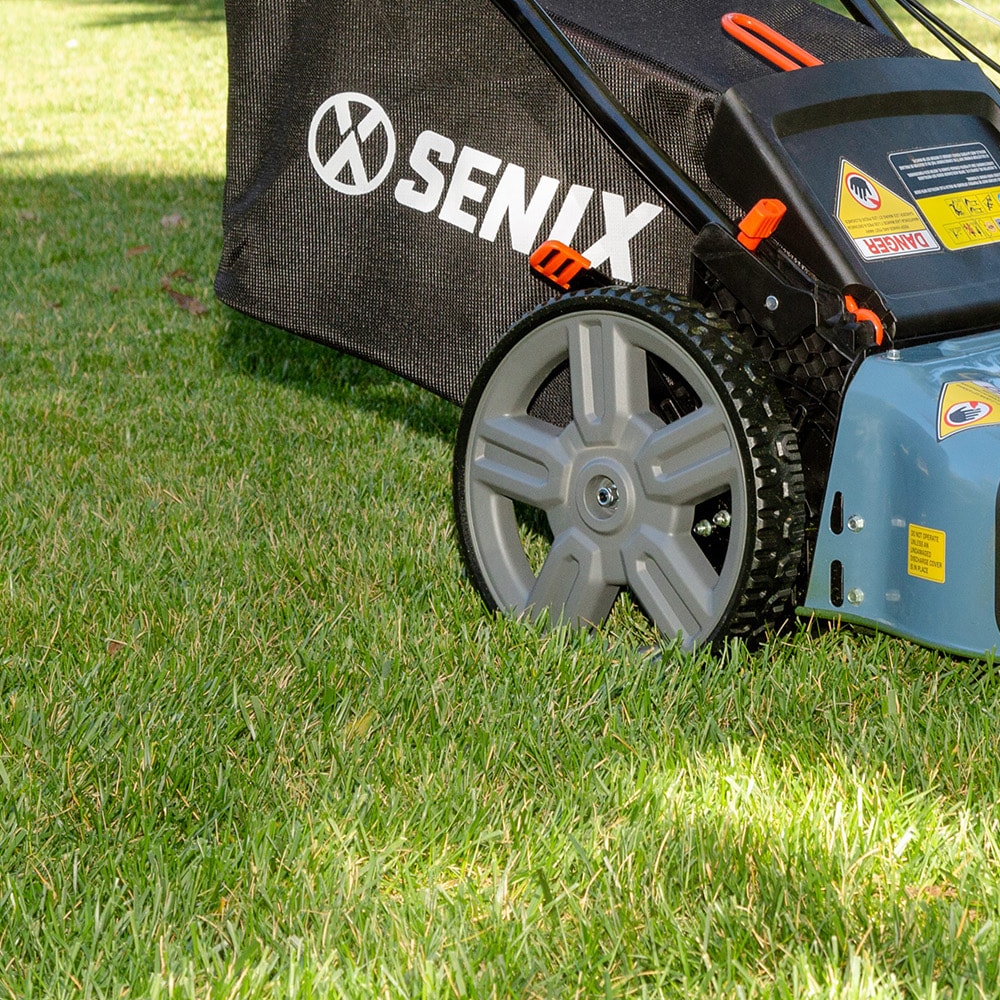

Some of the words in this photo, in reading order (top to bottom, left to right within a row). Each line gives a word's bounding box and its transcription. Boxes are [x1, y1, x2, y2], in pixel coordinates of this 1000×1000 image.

[394, 130, 664, 283] SENIX
[863, 232, 929, 254] DANGER
[923, 533, 938, 542] OPERATE
[930, 559, 942, 569] COVER
